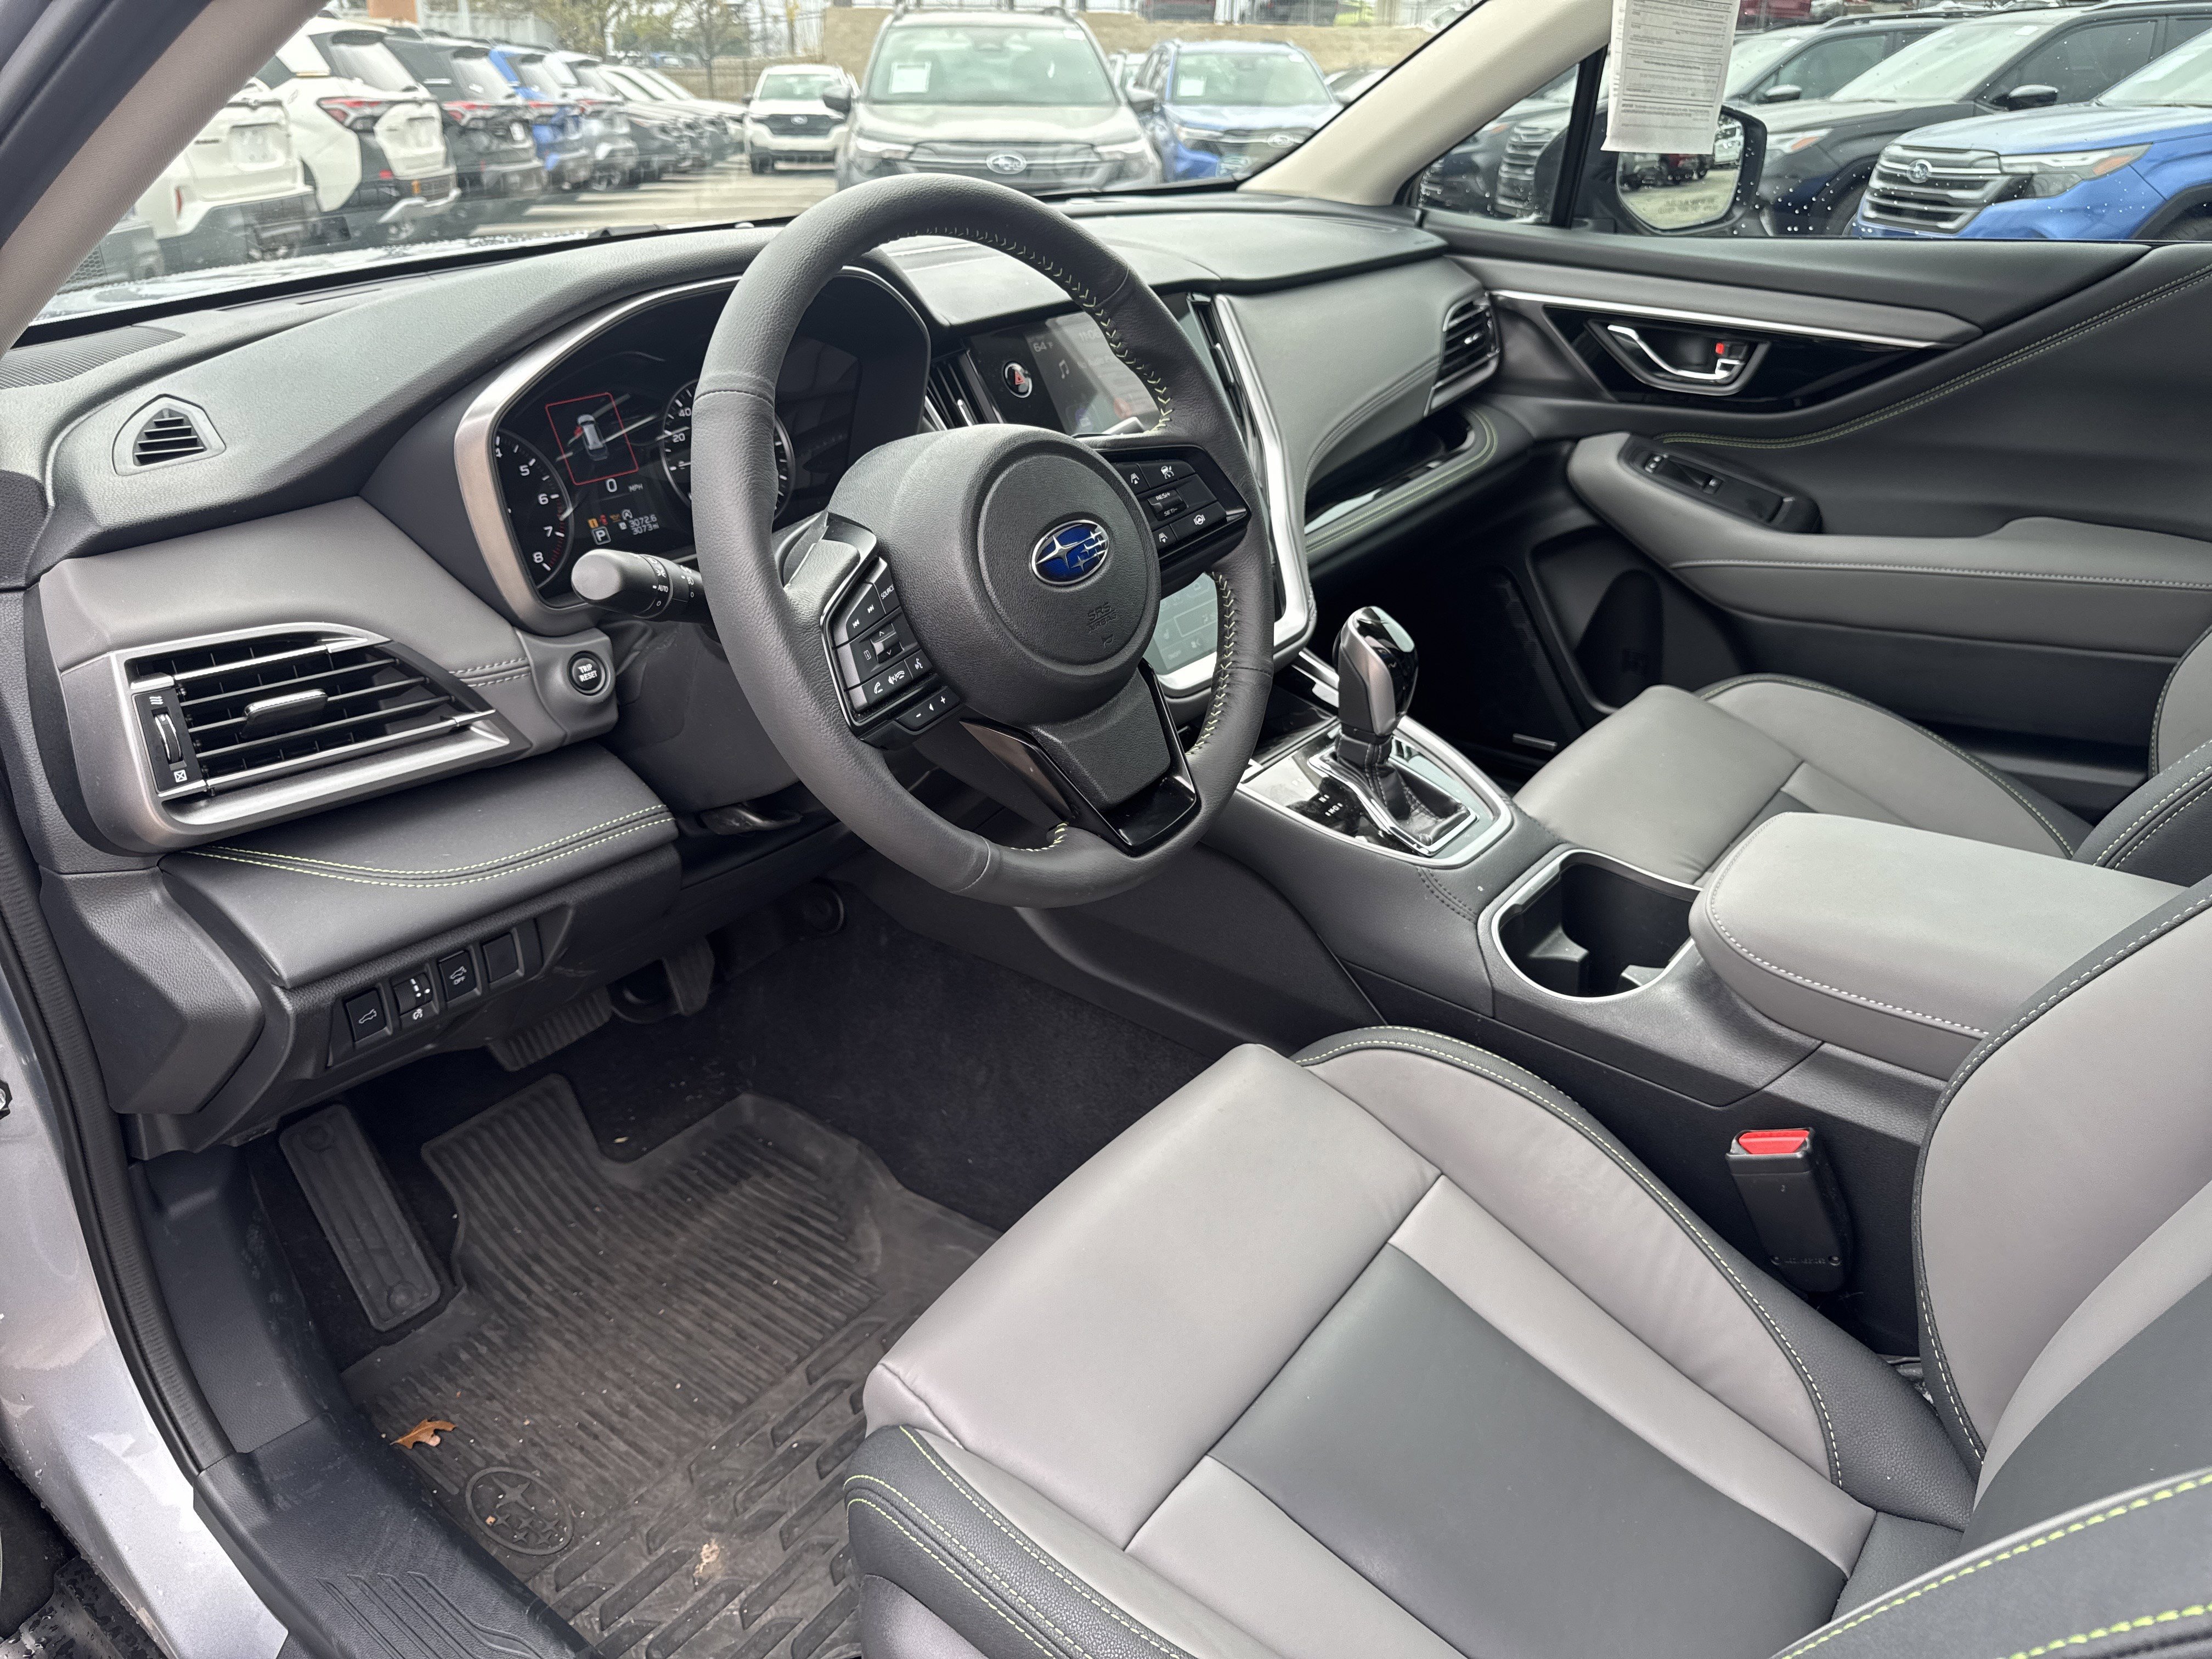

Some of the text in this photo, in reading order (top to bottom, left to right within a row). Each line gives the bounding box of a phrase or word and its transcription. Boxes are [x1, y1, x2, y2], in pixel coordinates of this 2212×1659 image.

[678, 407, 691, 417] 40
[673, 433, 685, 443] 20
[519, 465, 530, 476] 5
[606, 478, 644, 493] 0 MPH
[538, 494, 549, 505] 6
[629, 514, 657, 528] 3072.6
[543, 526, 552, 537] 7
[596, 529, 606, 541] P
[532, 551, 544, 563] 8
[658, 584, 669, 592] AUTO
[881, 584, 895, 600] SOURCE
[578, 663, 592, 674] TRIP
[579, 670, 597, 682] RESET
